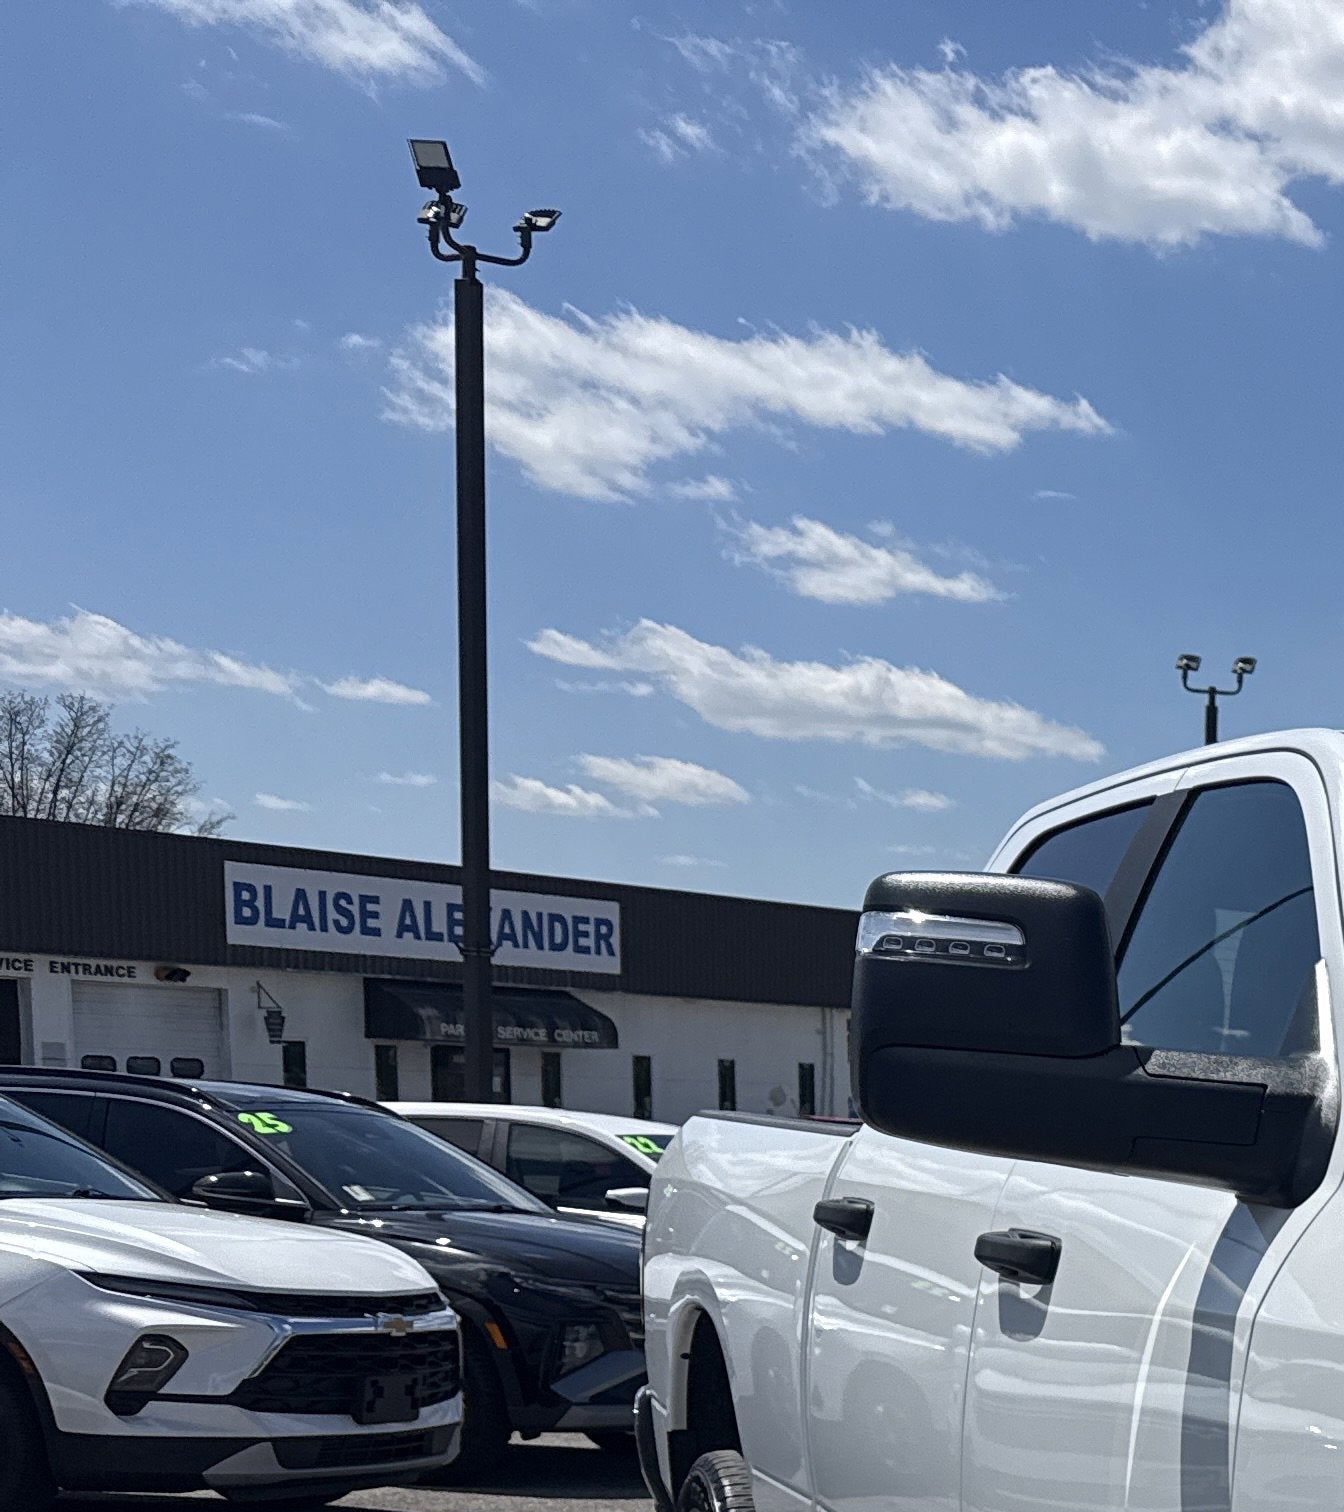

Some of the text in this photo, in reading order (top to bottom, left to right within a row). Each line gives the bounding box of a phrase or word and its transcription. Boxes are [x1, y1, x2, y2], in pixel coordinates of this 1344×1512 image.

[232, 880, 617, 958] BLAISE ALEANDER
[49, 960, 137, 978] ENTRANCE
[497, 1026, 548, 1042] SERVICE
[554, 1029, 600, 1043] CENTER
[237, 1111, 294, 1134] 25
